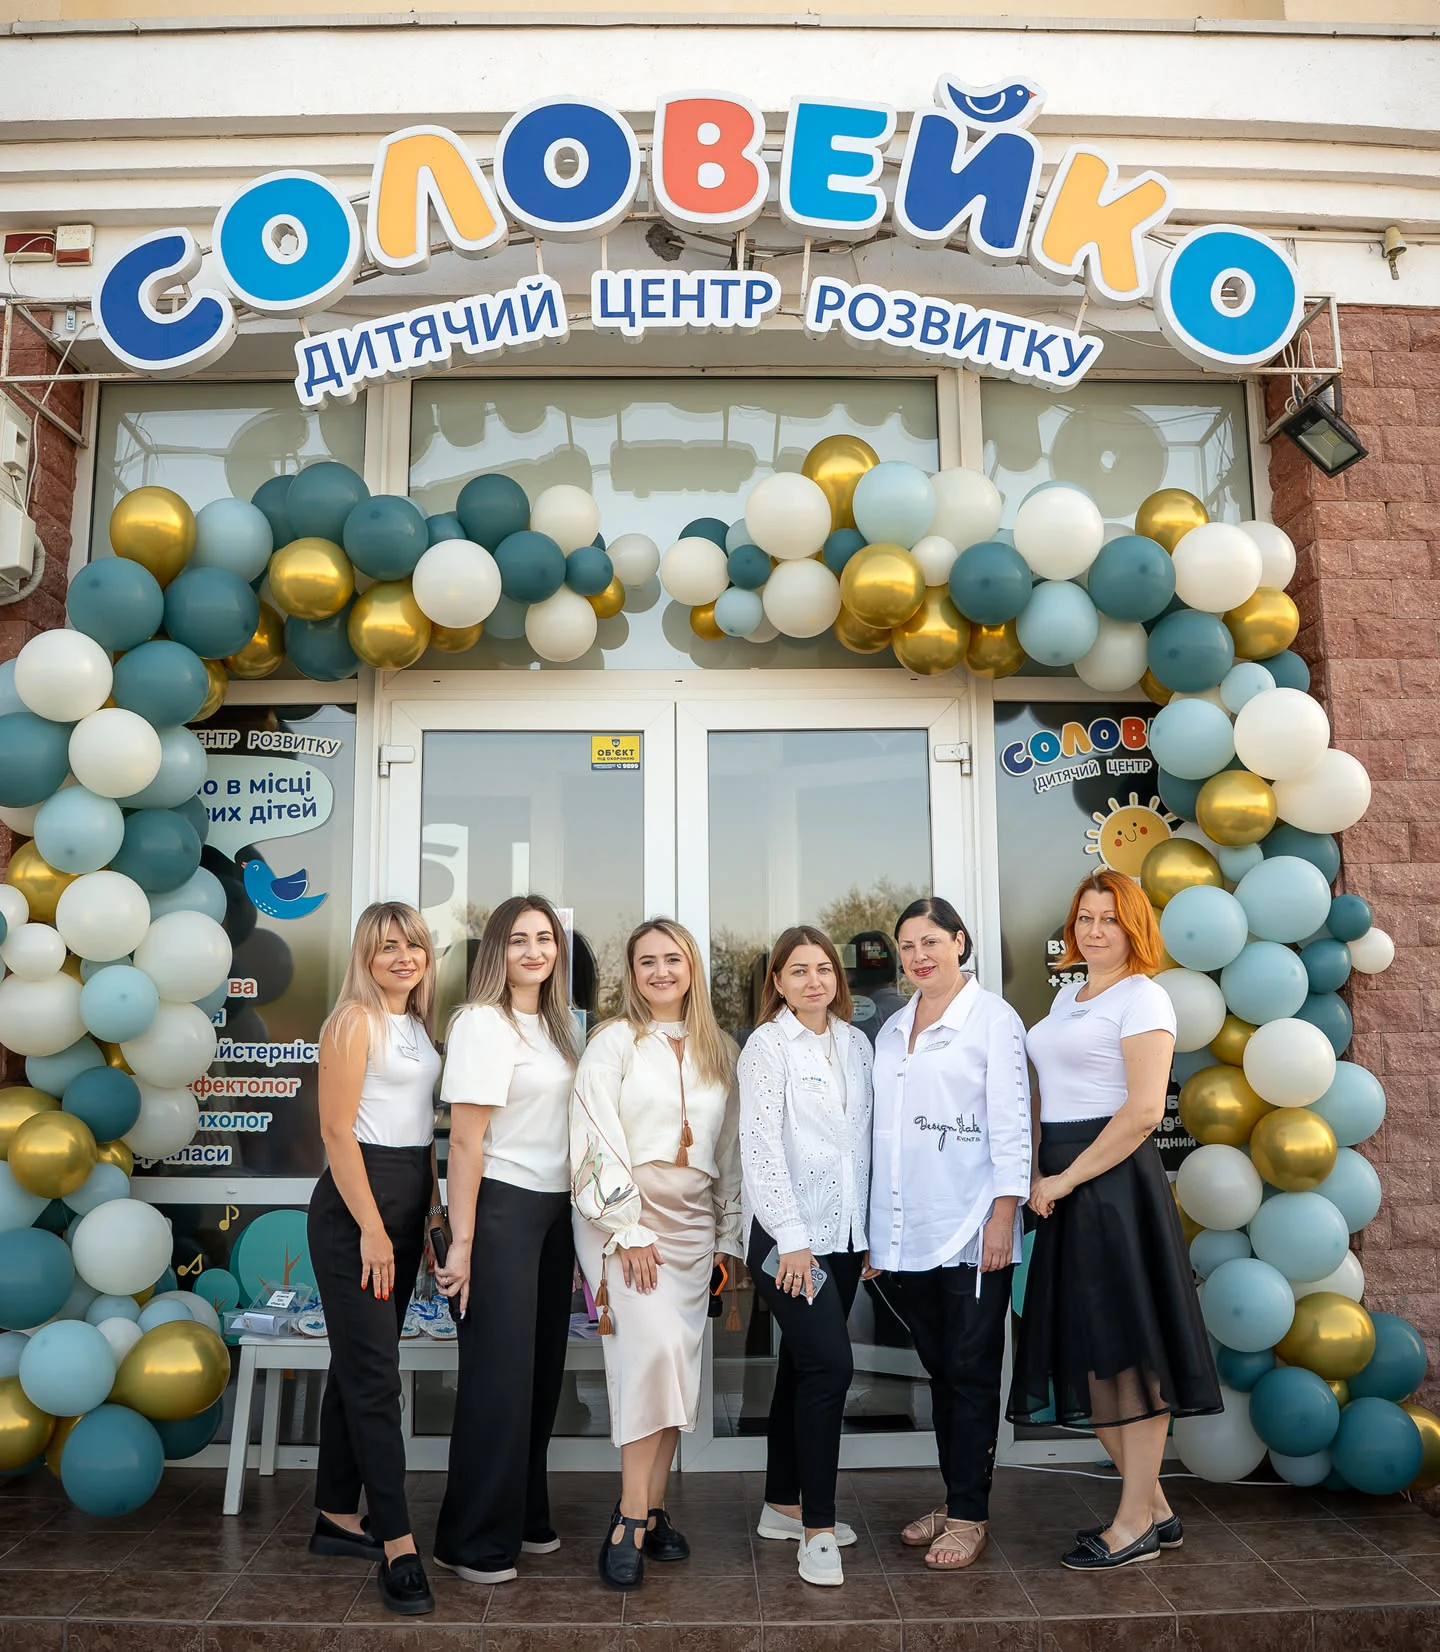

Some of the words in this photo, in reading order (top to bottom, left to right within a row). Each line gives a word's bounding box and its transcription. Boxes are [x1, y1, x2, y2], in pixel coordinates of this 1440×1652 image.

[97, 76, 1299, 366] СОЛОВЕЙКО
[303, 283, 559, 398] ДИТЯЧИЙ
[601, 277, 774, 328] ЦЕНТР
[815, 284, 1095, 378] РОЗВИТКУ
[250, 733, 338, 754] РОЗВИТКУ
[1003, 718, 1155, 774] СОЛОВ
[227, 780, 241, 794] в
[250, 770, 311, 796] місці
[1037, 761, 1099, 790] ДИТЯЧИЙ
[1107, 760, 1150, 775] ЦЕНТР
[250, 796, 317, 825] дітей
[914, 1115, 957, 1152] Design
